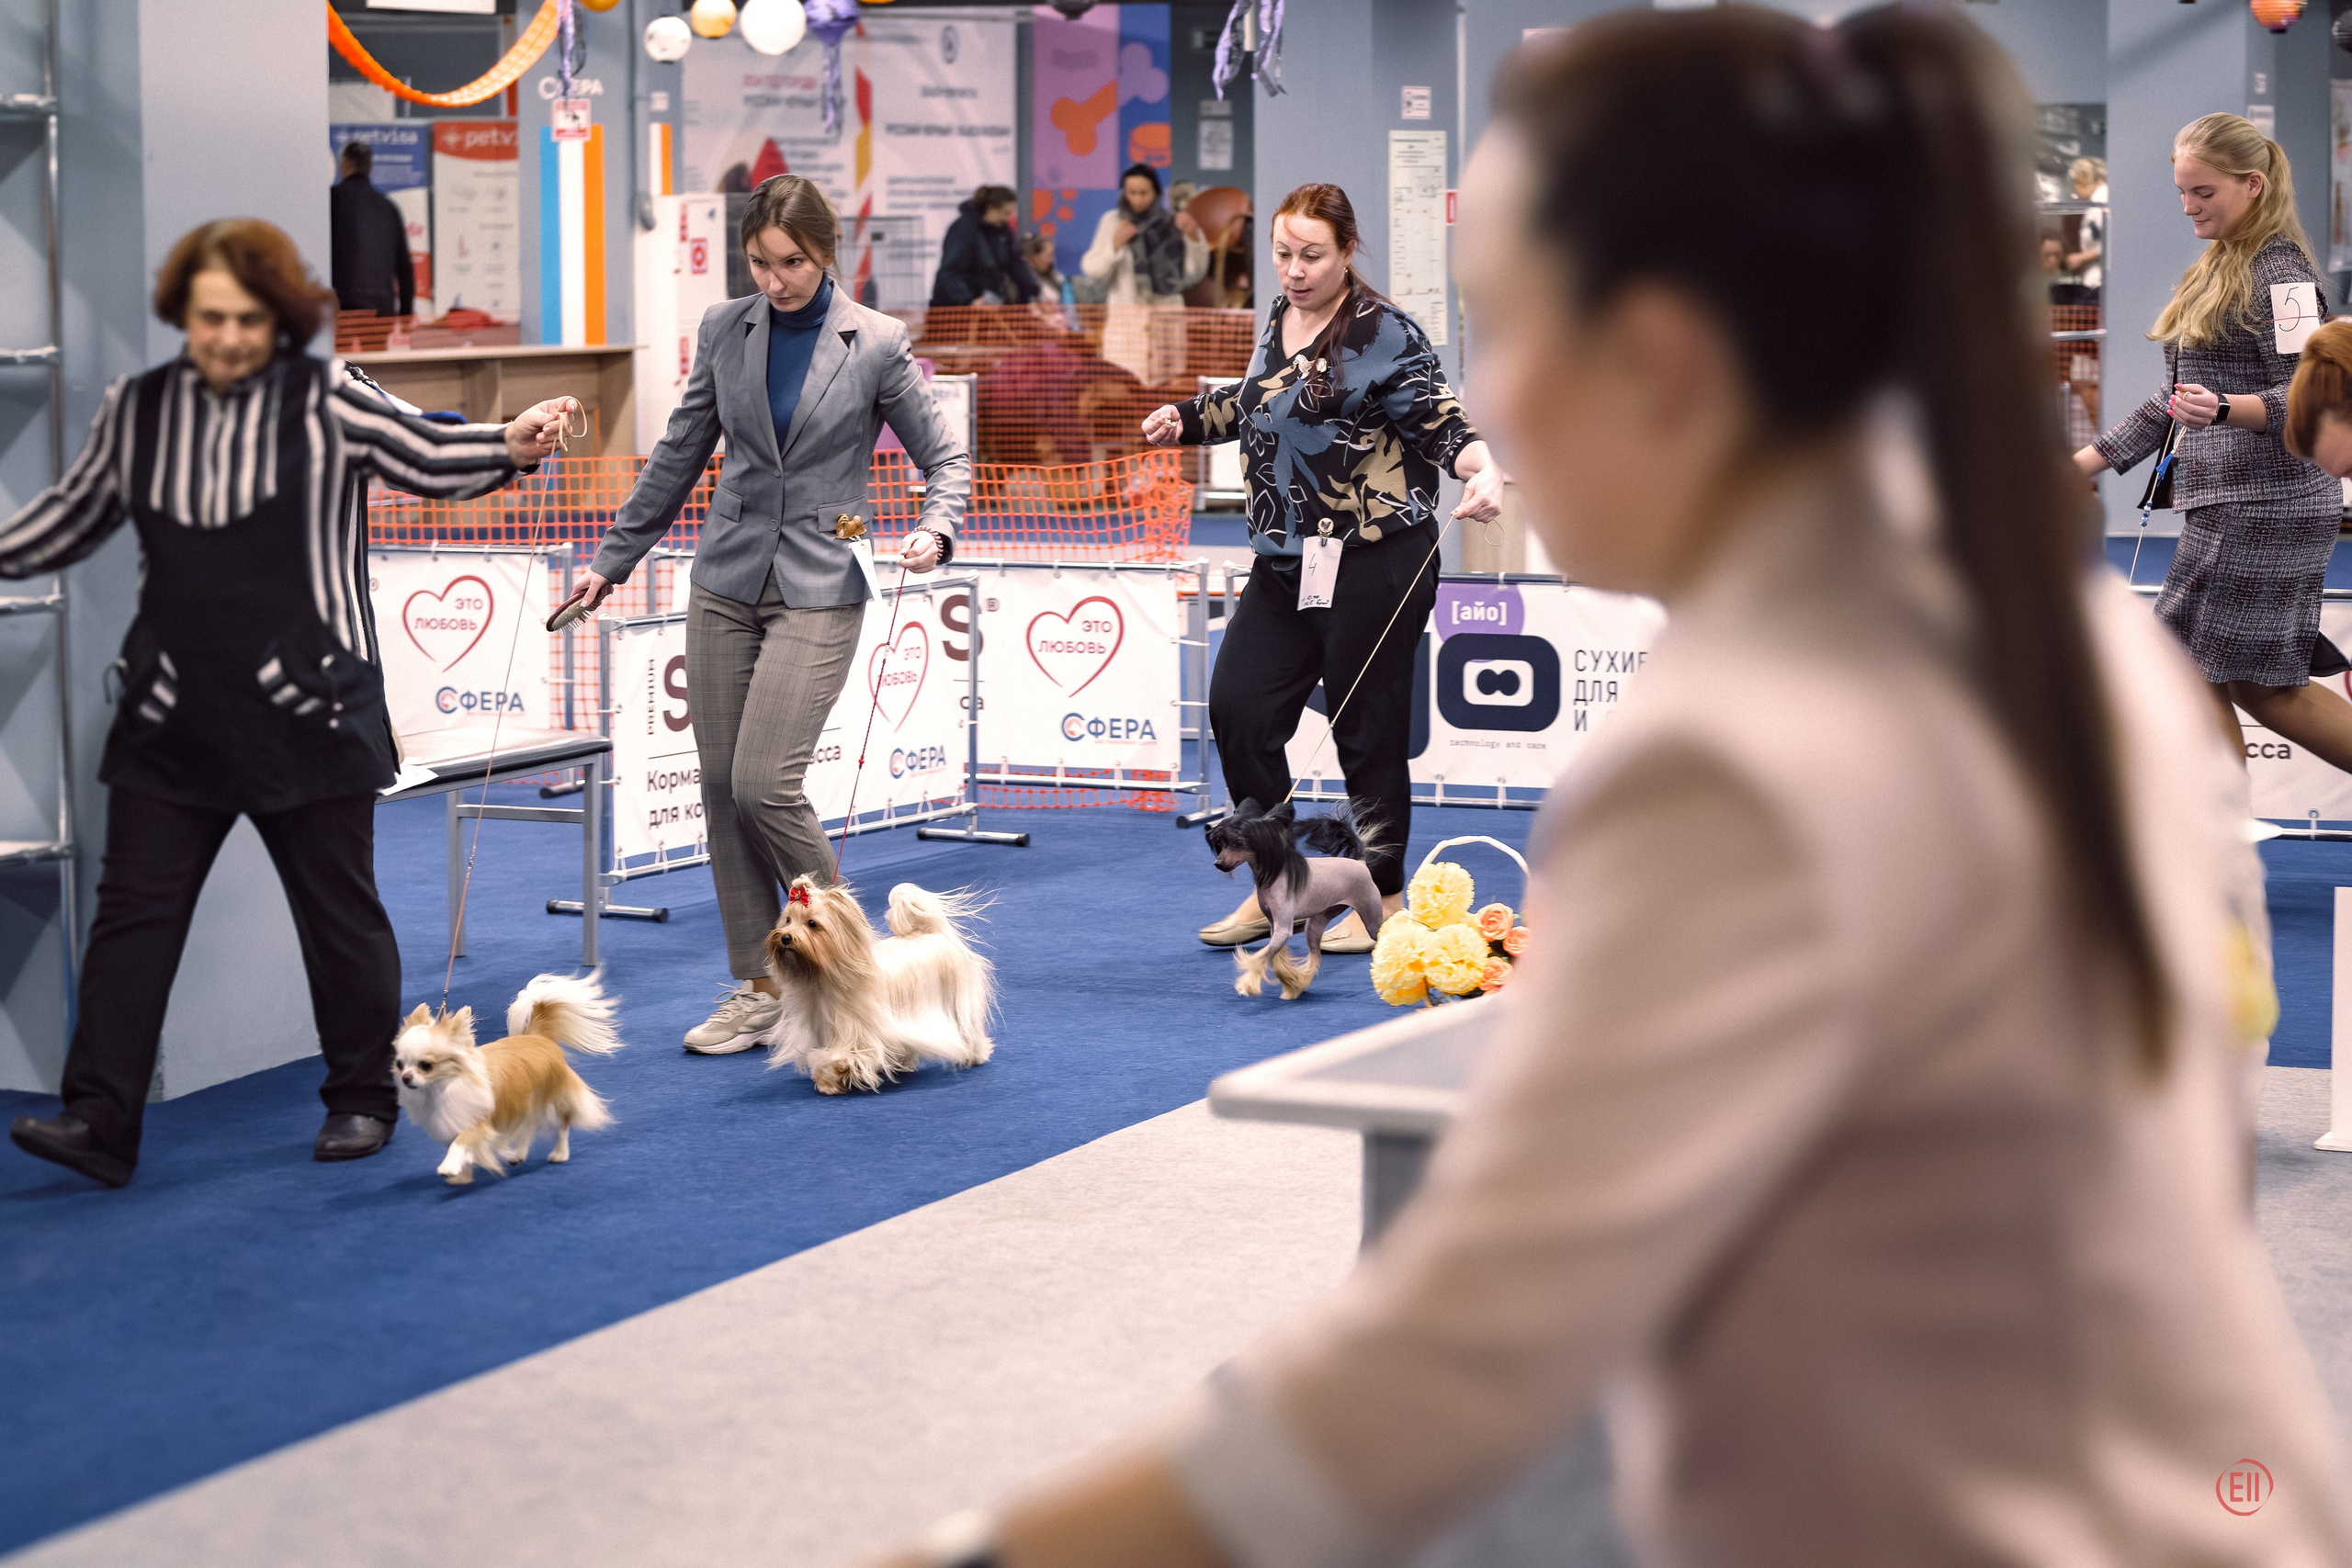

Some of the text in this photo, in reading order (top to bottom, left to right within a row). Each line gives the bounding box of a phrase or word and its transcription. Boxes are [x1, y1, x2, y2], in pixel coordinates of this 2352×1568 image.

[2278, 287, 2301, 332] 5
[1308, 553, 1317, 576] 4
[455, 598, 483, 611] ЭТО
[414, 618, 478, 631] ЛЮБОВЬ
[1081, 620, 1113, 633] ЭТО
[903, 647, 922, 660] ЭТО
[1038, 640, 1106, 654] ЛЮБОВЬ
[877, 671, 918, 687] ЛЮБОВЬ
[435, 686, 525, 714] СФЕРА
[647, 659, 656, 735] PREMIUM
[1573, 680, 1618, 705] ДЛЯ
[1061, 712, 1157, 741] СФЕРА
[1574, 709, 1588, 731] И
[889, 745, 946, 779] СФЕРА
[2245, 742, 2291, 760] сса
[647, 768, 701, 795] Корма
[649, 806, 680, 830] для
